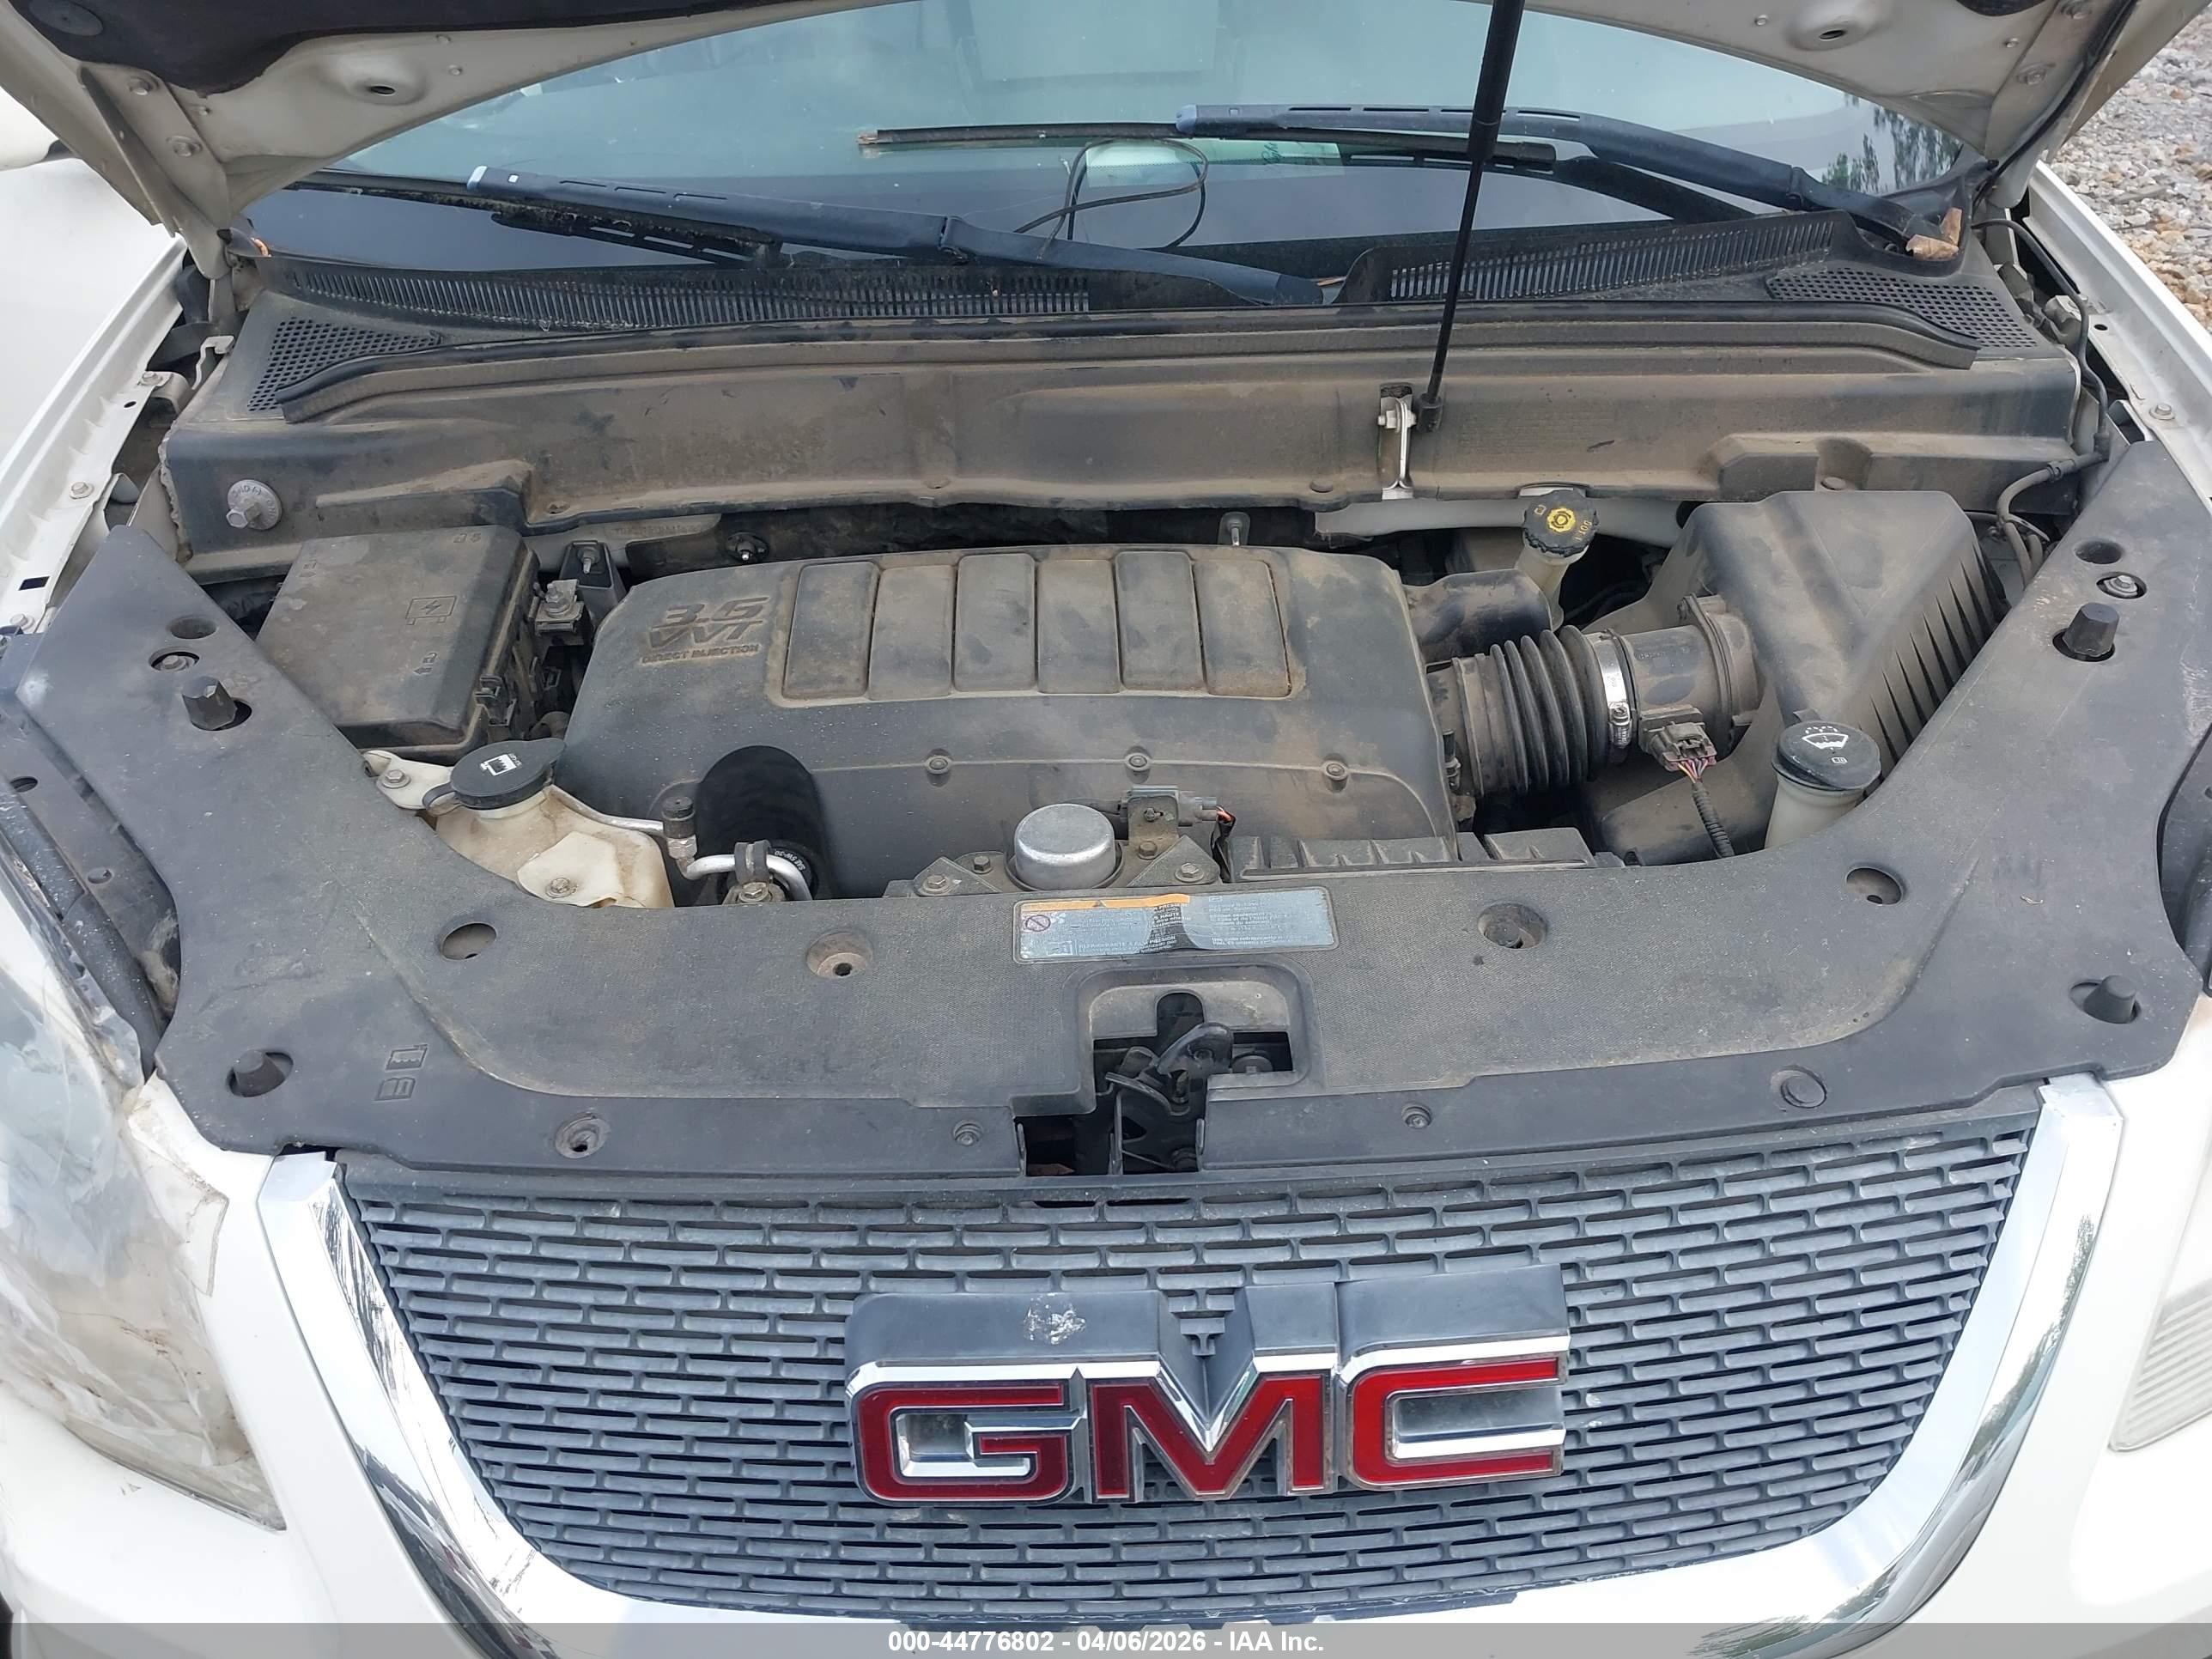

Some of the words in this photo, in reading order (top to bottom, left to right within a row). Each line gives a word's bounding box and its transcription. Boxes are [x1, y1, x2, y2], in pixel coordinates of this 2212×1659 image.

[649, 620, 763, 649] VVT
[641, 648, 690, 664] DIRECT
[690, 643, 760, 659] INJECTION
[775, 850, 797, 861] 5W-30
[793, 859, 806, 871] SAE
[846, 1334, 1571, 1504] GMC
